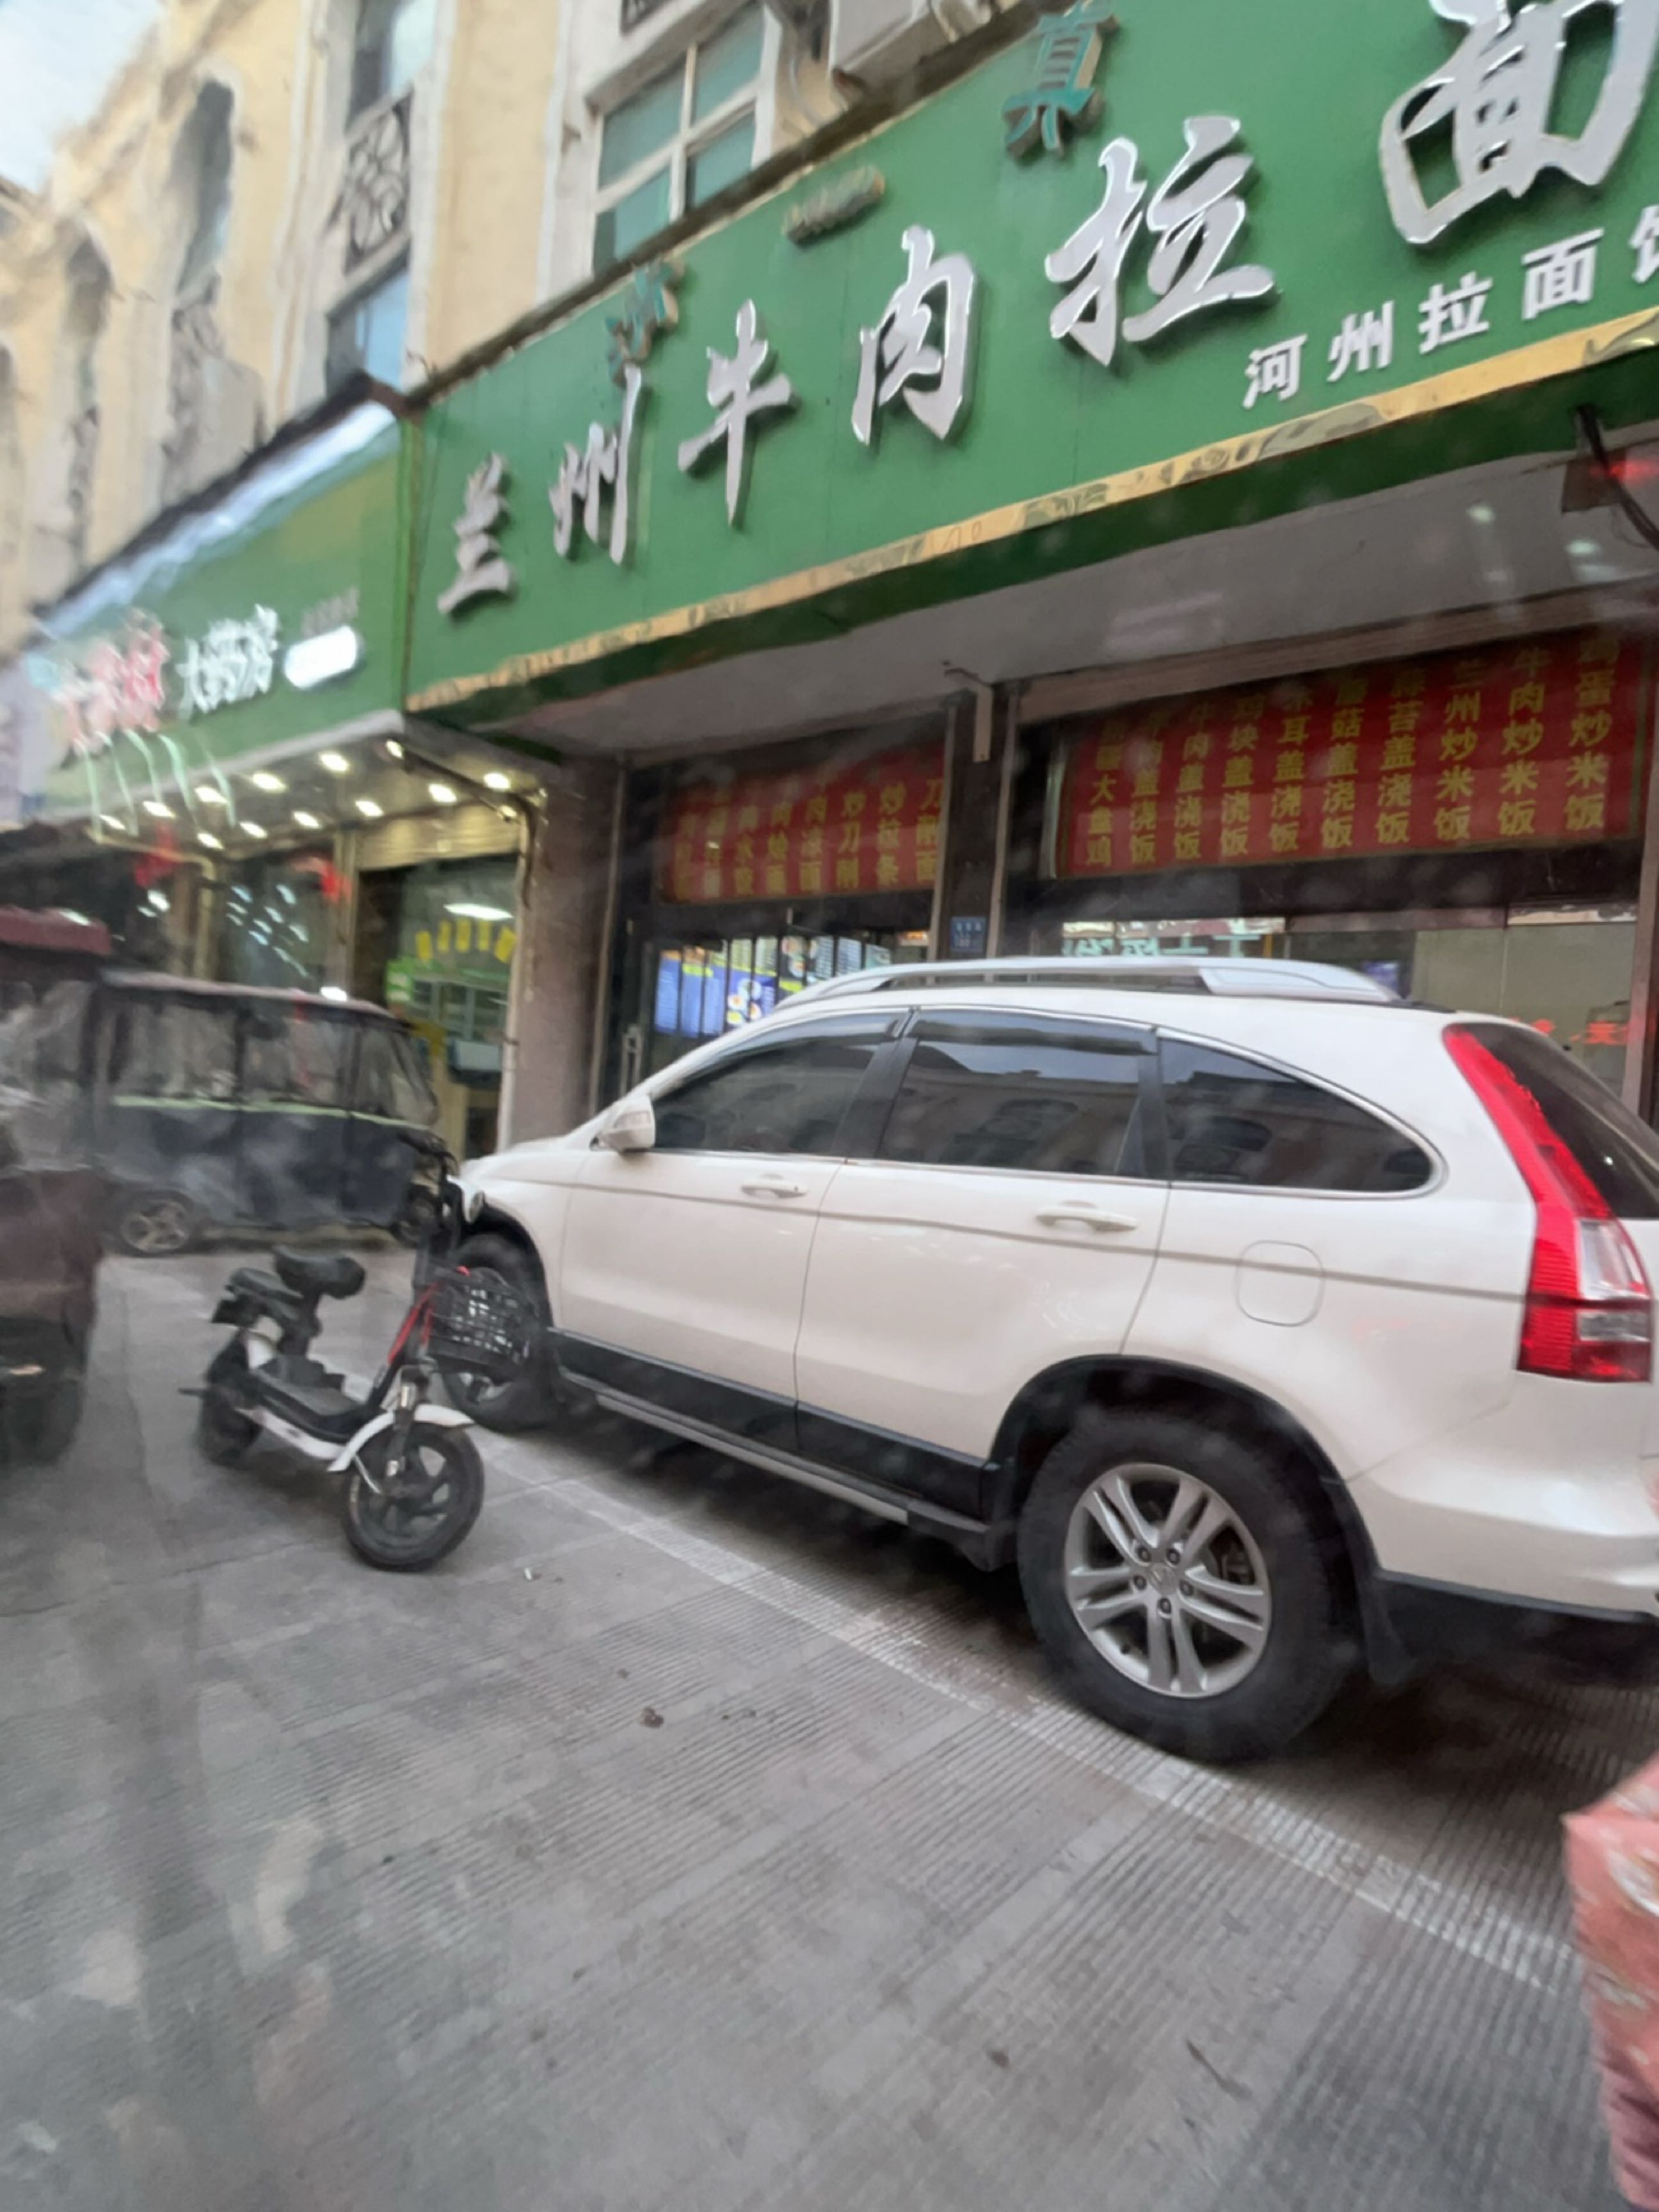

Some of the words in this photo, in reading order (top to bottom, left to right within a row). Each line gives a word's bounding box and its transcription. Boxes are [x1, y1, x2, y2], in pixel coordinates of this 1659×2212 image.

[1001, 0, 1119, 156] 真
[438, 0, 1659, 614] 兰州牛肉拉面
[1497, 646, 1551, 837] 牛肉炒米饭
